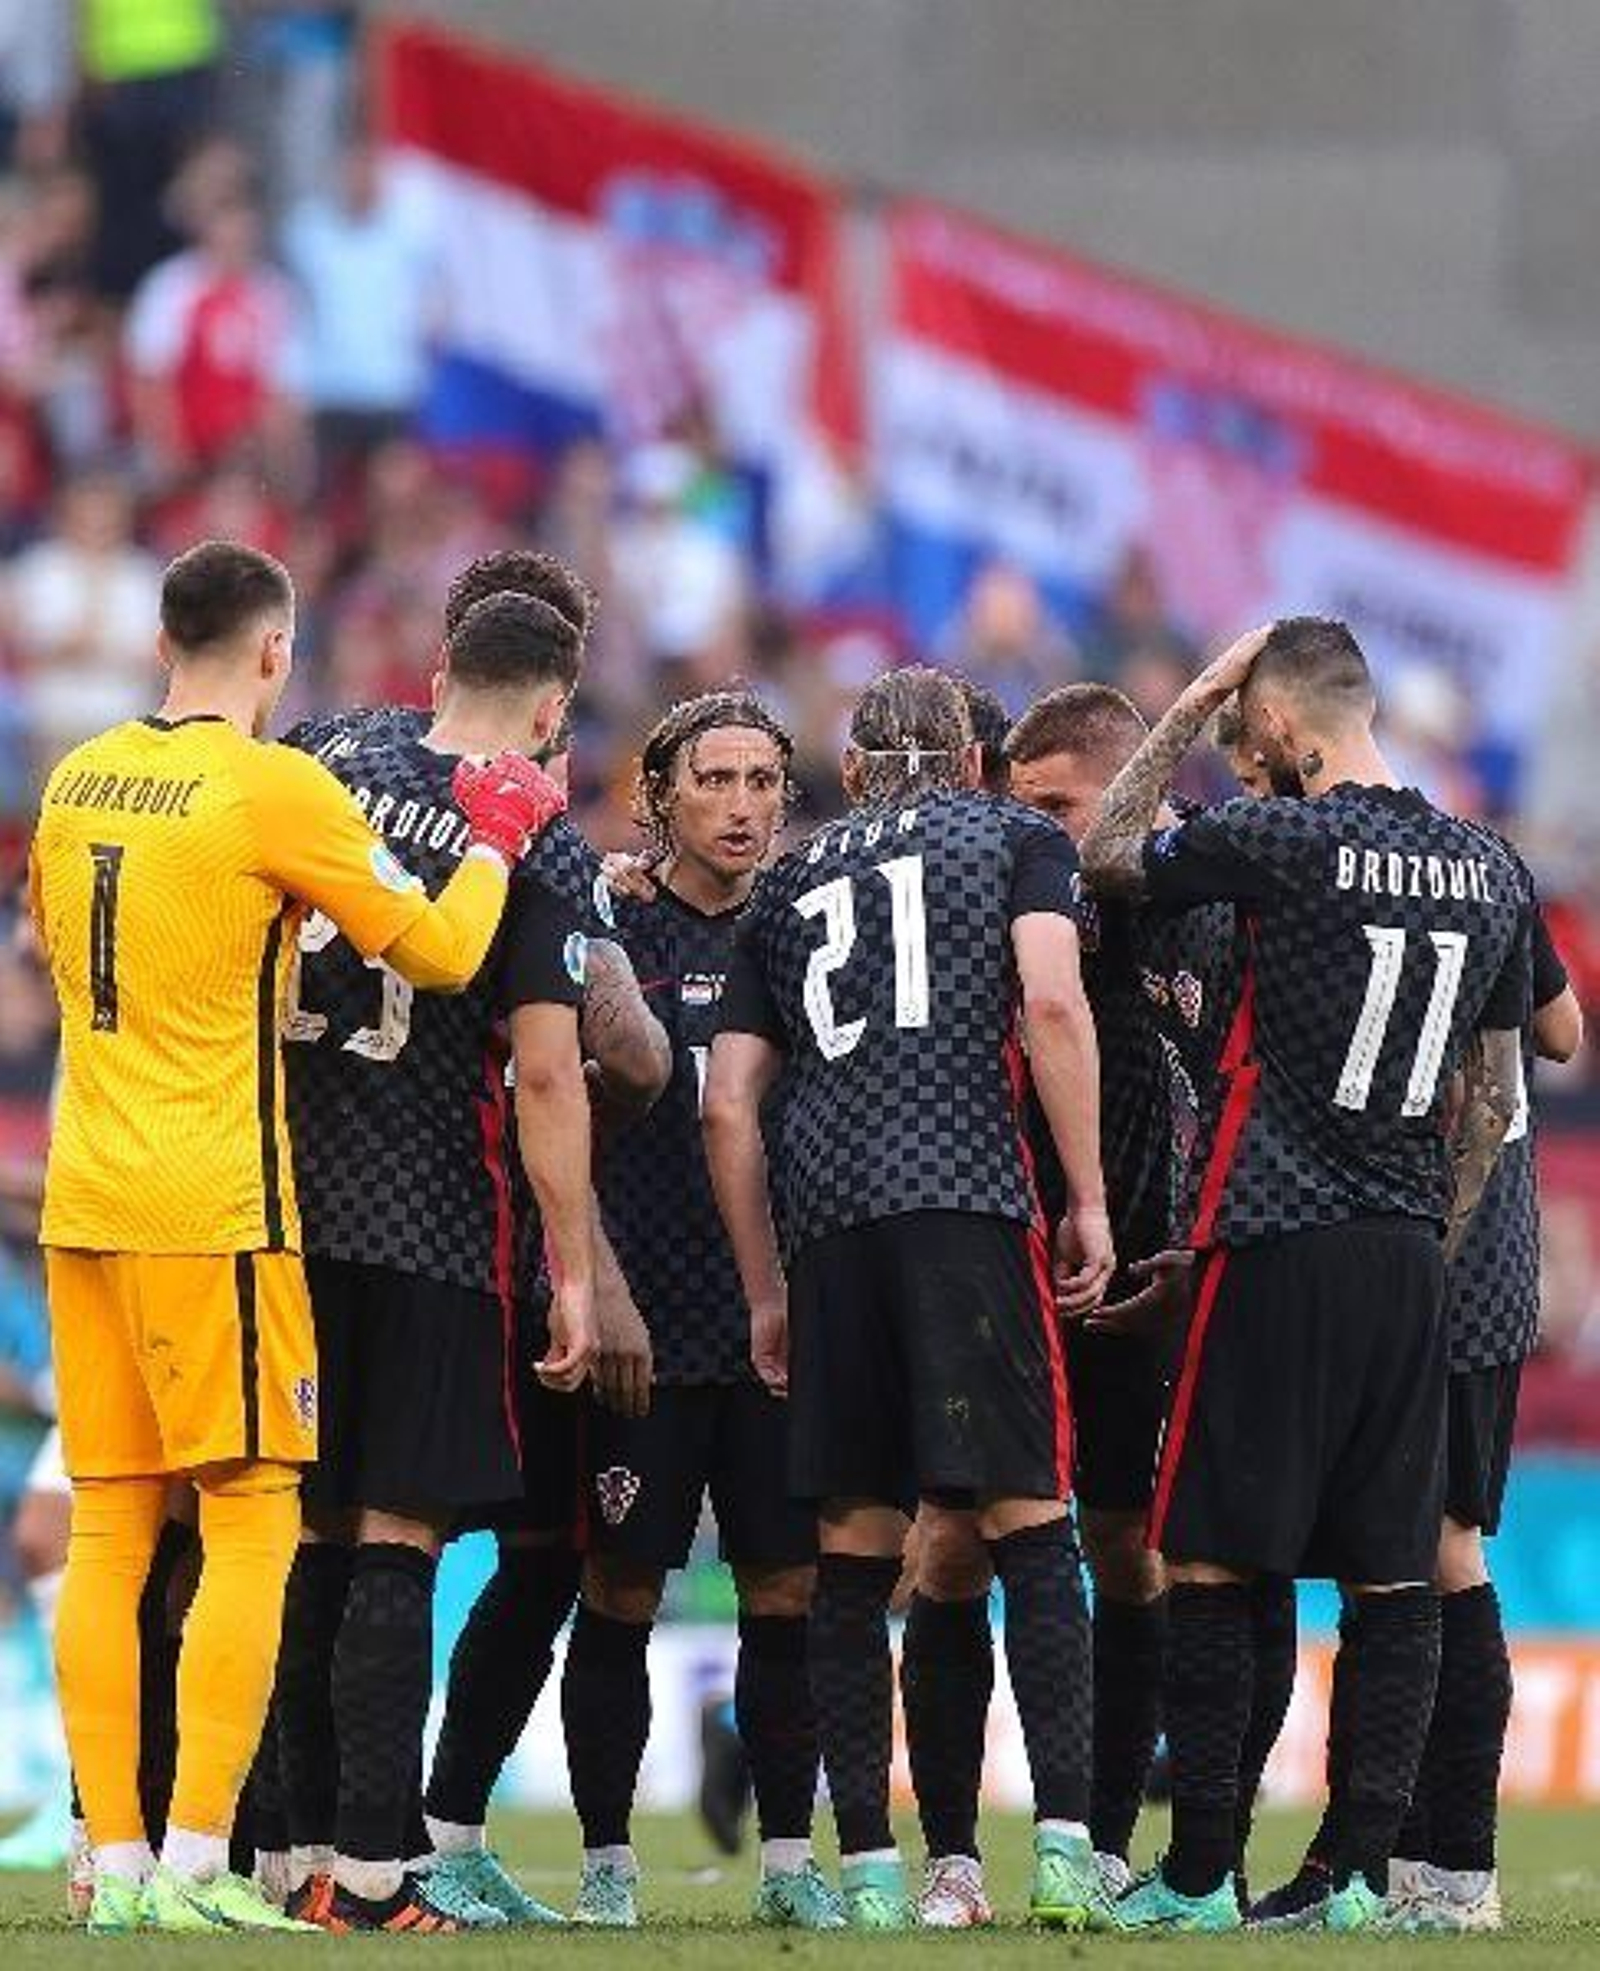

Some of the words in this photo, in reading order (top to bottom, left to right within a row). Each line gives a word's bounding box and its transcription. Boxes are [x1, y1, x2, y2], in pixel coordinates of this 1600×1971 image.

[88, 843, 124, 1034] 1
[791, 853, 930, 1062] 21
[1335, 845, 1496, 903] BROZOVIĆ
[1332, 924, 1469, 1117] 11
